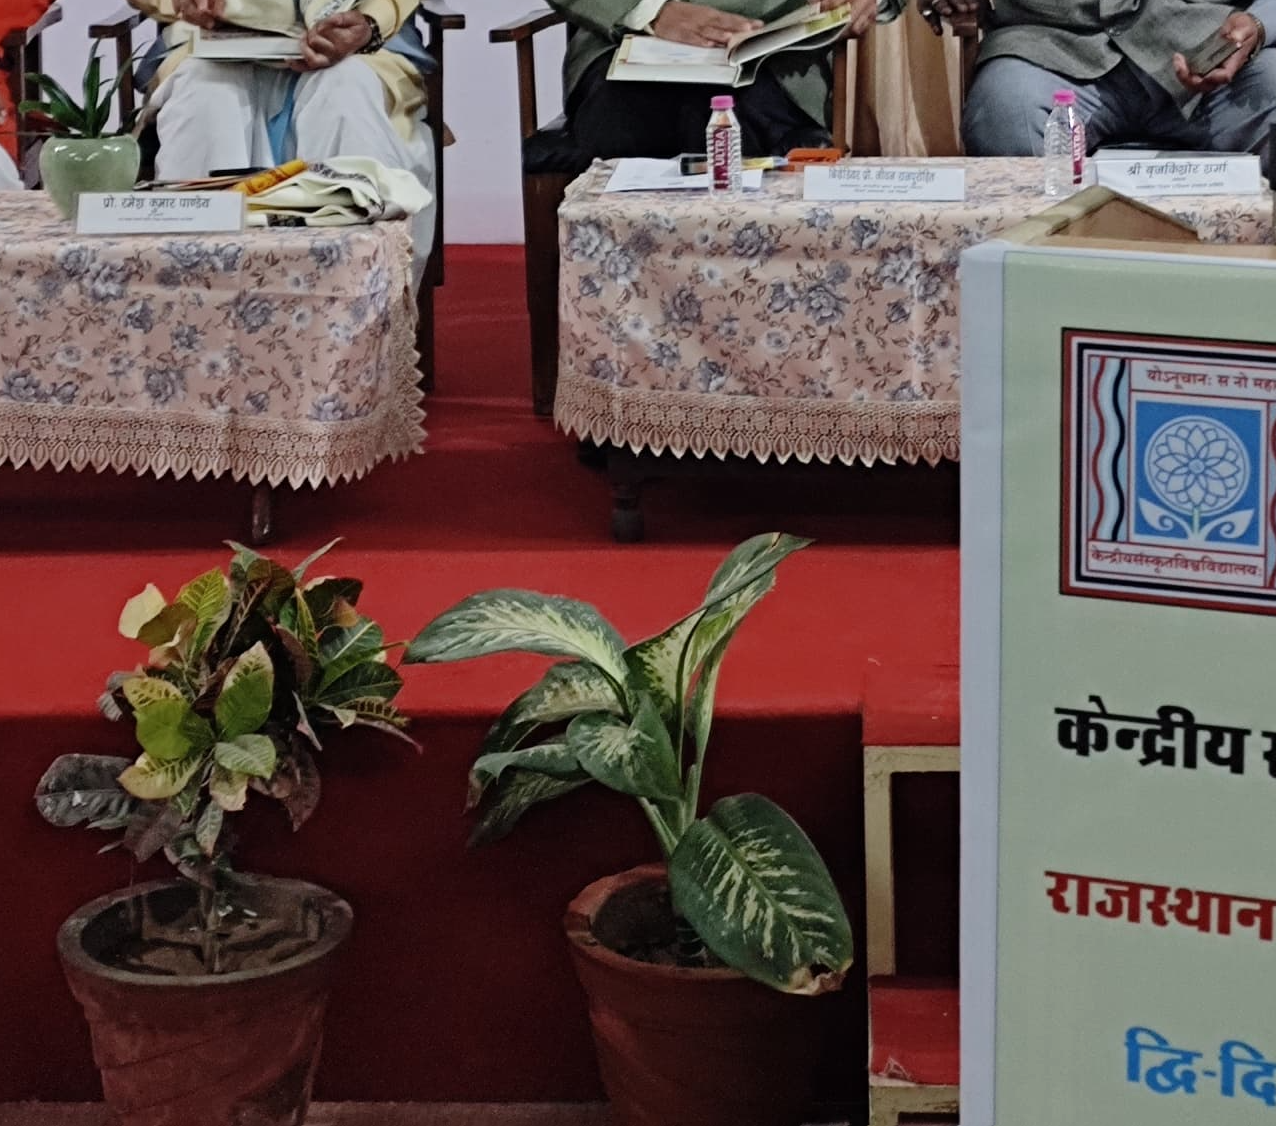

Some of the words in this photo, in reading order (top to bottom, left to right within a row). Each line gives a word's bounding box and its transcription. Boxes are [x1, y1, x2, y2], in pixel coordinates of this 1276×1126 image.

[714, 131, 726, 166] ULTRA
[1126, 161, 1142, 176] श्री
[1204, 160, 1228, 174] शर्मा
[121, 194, 146, 209] रमेश
[149, 196, 176, 213] कुमार
[1054, 695, 1250, 775] केन्द्रीय
